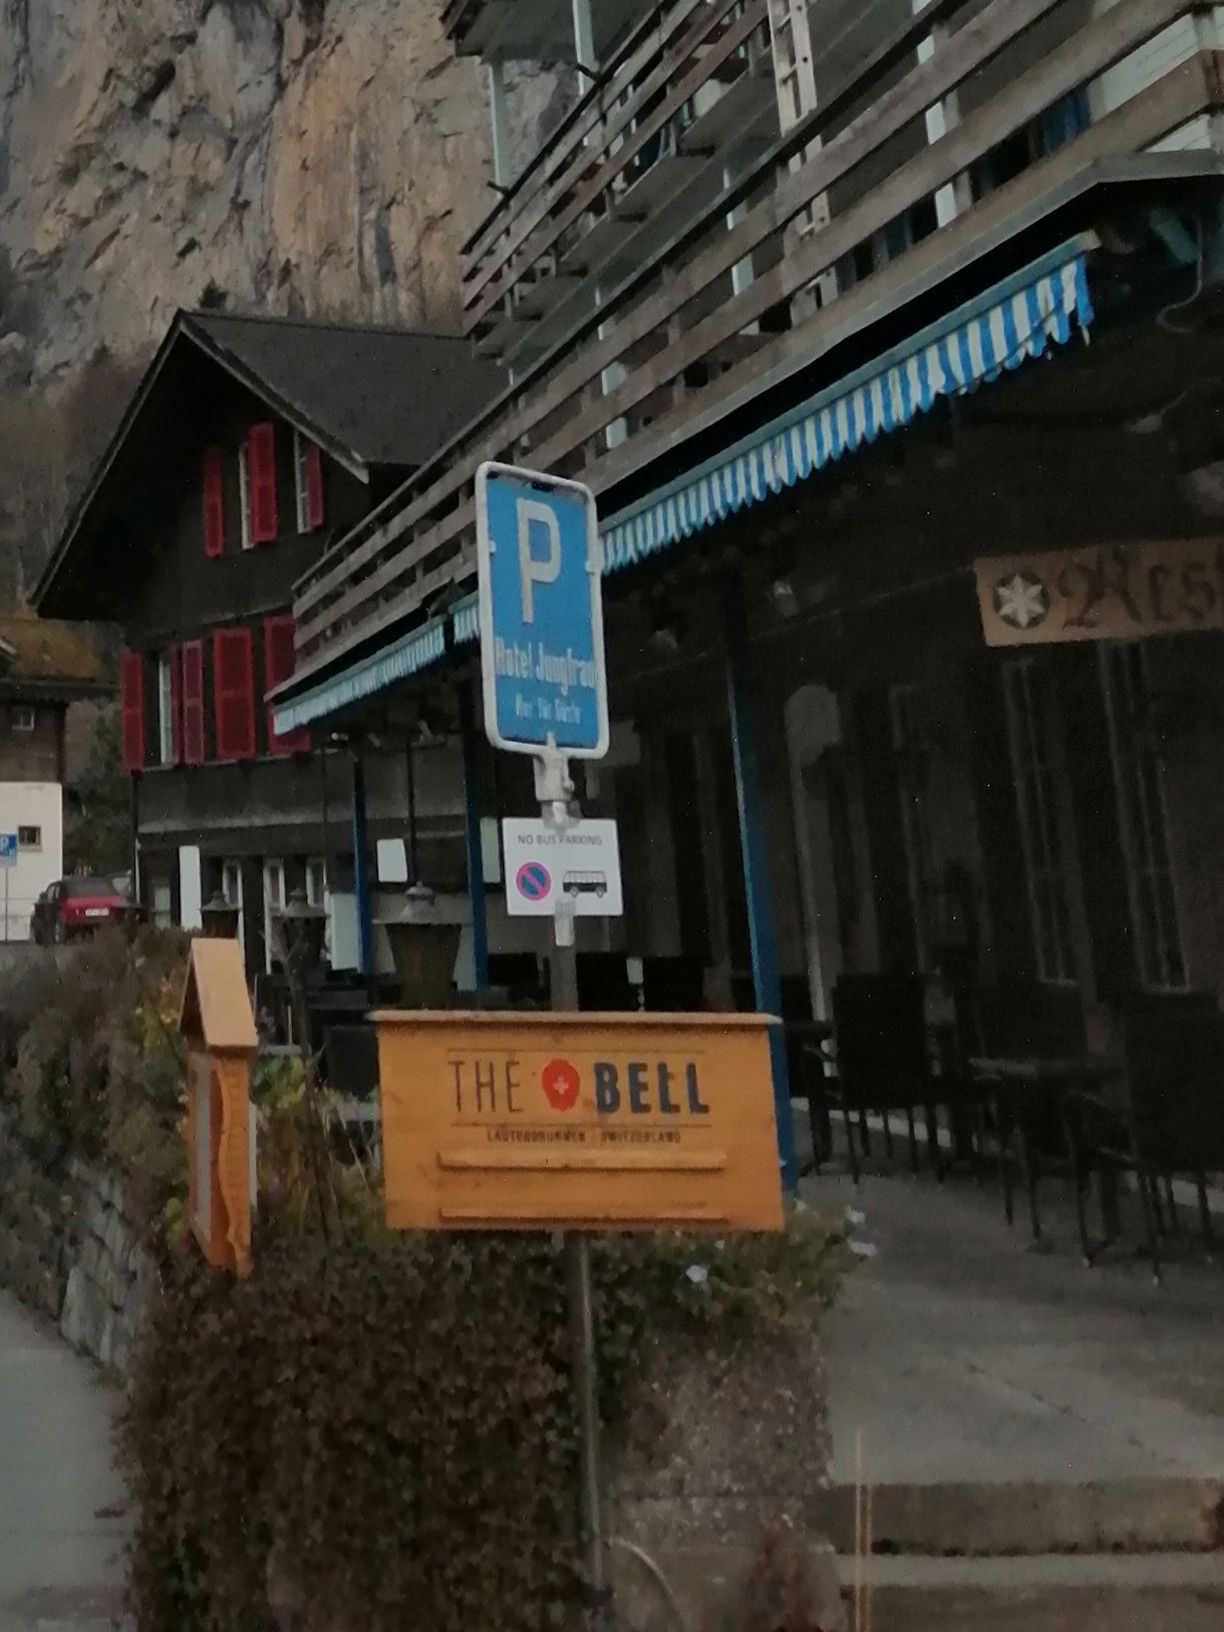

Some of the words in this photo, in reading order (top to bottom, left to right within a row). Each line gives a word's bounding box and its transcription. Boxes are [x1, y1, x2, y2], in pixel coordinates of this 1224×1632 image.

[516, 496, 562, 625] P
[1057, 542, 1223, 630] Res
[494, 635, 534, 679] Hotel
[536, 642, 599, 696] Jungfrau
[517, 834, 533, 845] NO
[536, 834, 556, 845] BUS
[559, 834, 603, 846] PARKING
[448, 1059, 525, 1114] THE
[594, 1061, 711, 1115] BELL
